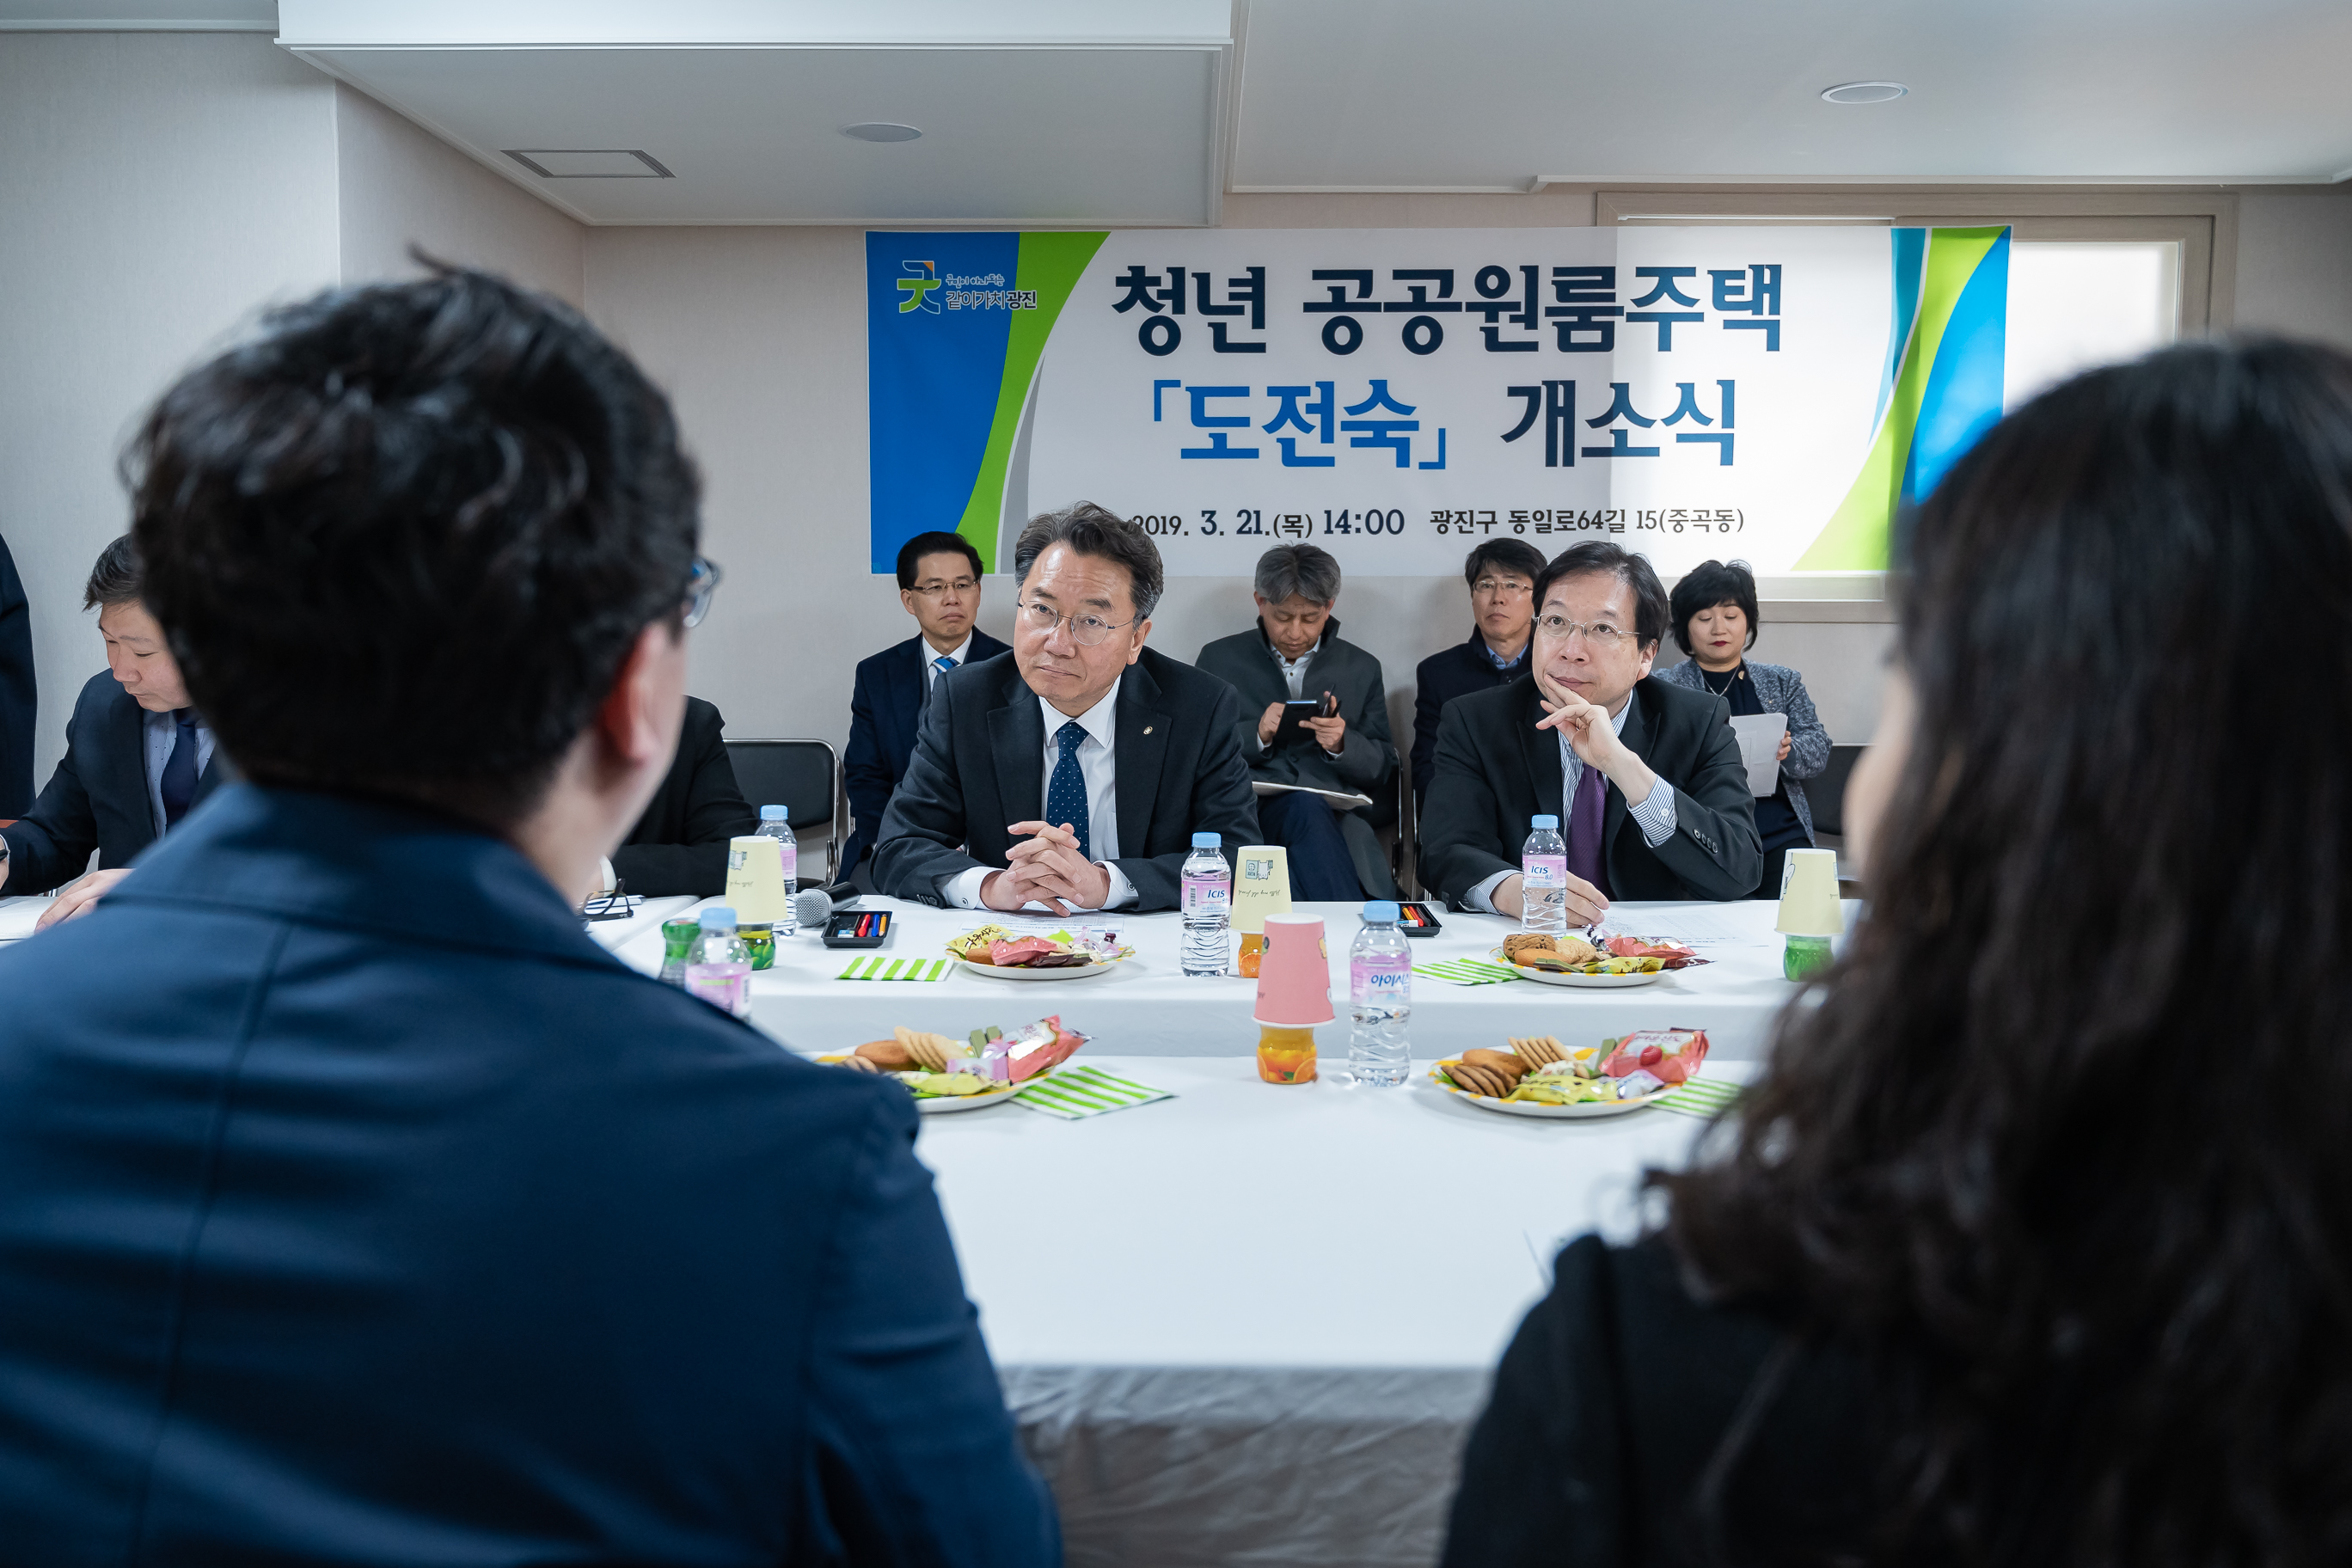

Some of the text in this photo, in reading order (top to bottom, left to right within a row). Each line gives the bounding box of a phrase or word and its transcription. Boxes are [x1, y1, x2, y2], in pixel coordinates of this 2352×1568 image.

[1112, 264, 1782, 357] 청년 공공원룸주택
[1154, 379, 1735, 470] 「도전숙」 개소식
[1133, 516, 1188, 536] 2019.
[1201, 510, 1224, 536] 3.
[1324, 509, 1405, 535] 14:00
[1430, 509, 1743, 534] 광진구 동일로64길 15(중곡동)
